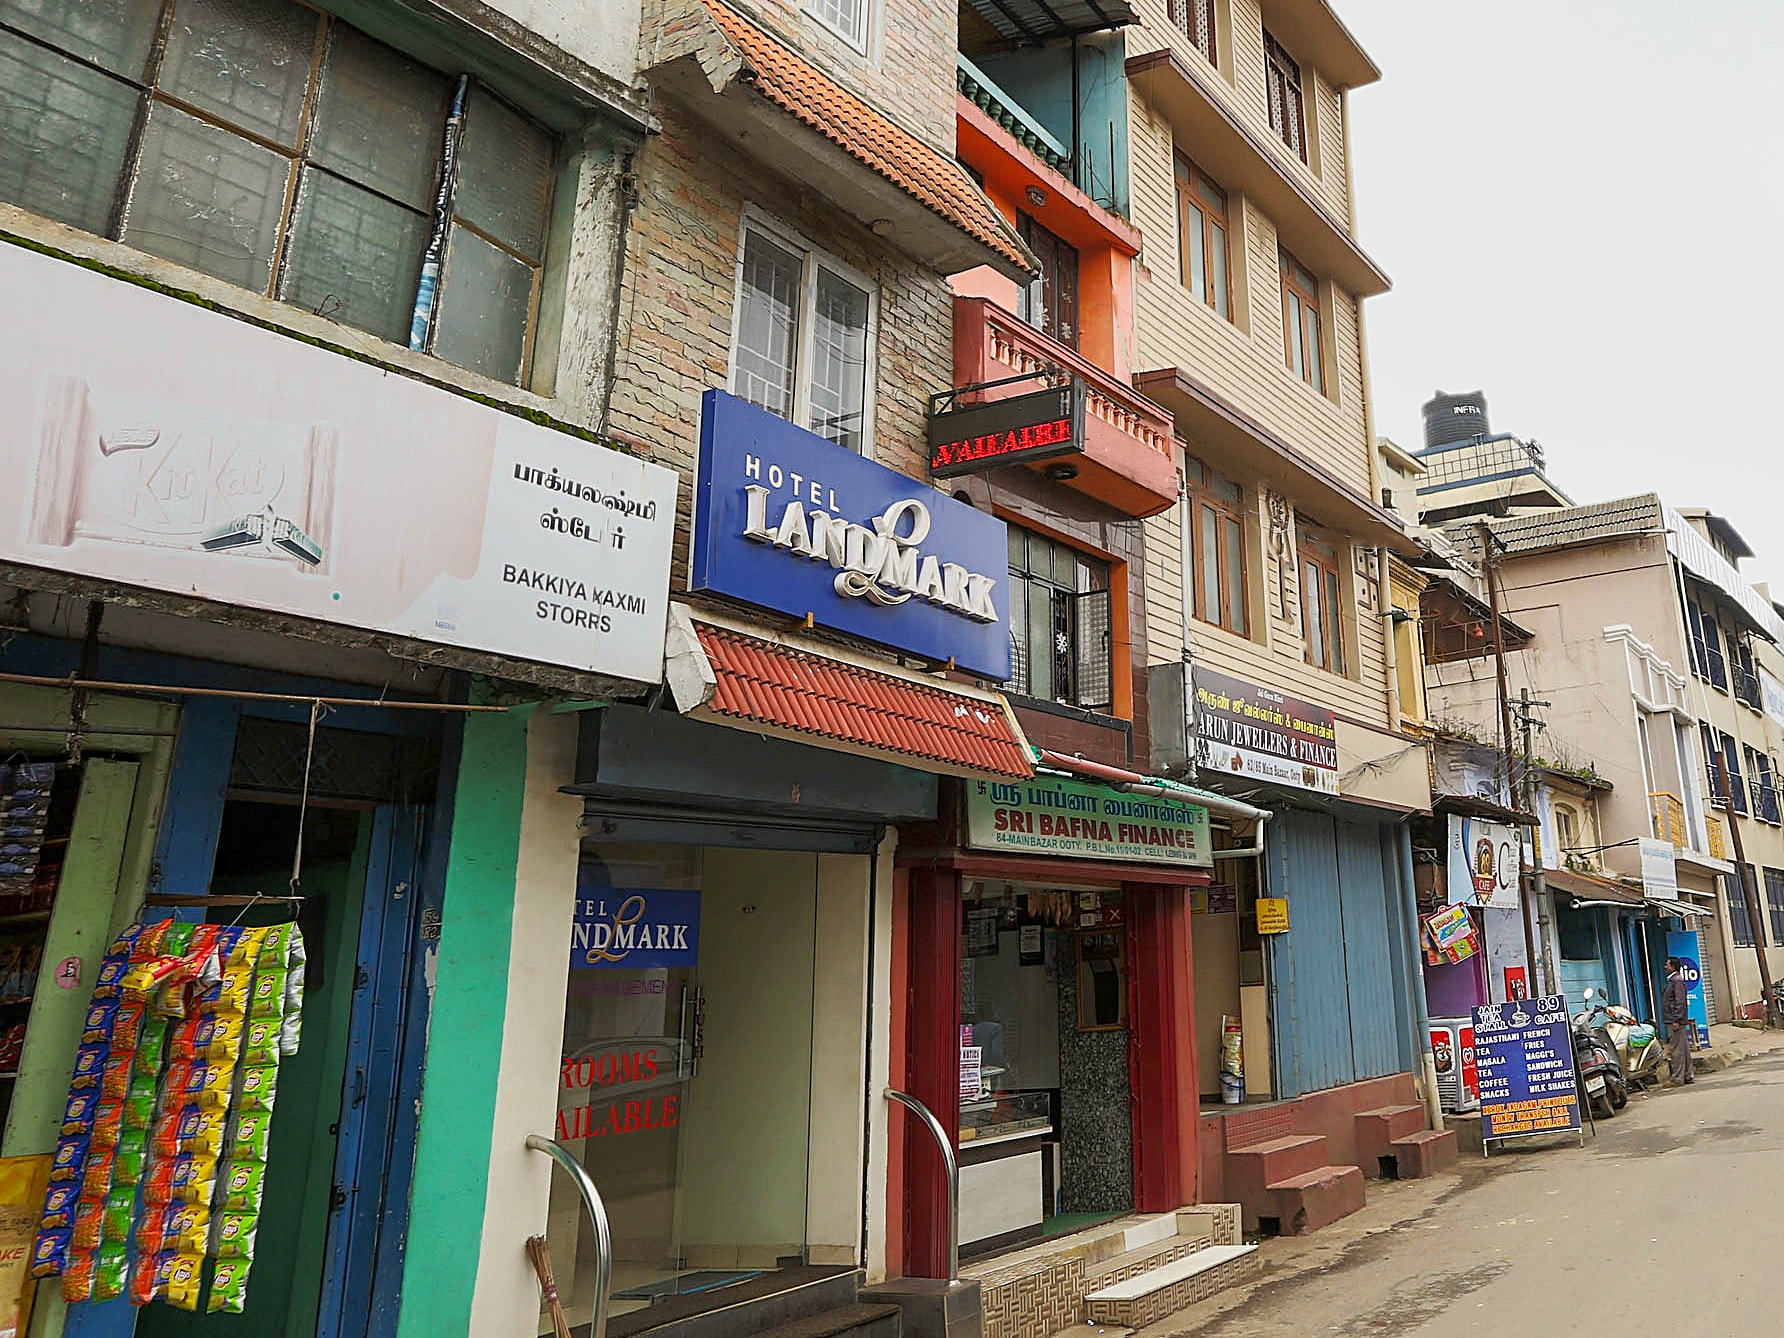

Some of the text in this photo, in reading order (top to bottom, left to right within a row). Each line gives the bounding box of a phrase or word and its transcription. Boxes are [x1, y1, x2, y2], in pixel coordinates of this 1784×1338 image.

[1453, 404, 1481, 415] INFRA
[745, 453, 841, 513] HOTEL
[742, 484, 1000, 625] LANDMARK
[502, 564, 587, 601] BAKKIYA
[1197, 712, 1337, 768] ARUN JEWELLERS & FINANCE
[994, 807, 1195, 849] SRI BAFNA FINANCE
[1477, 1004, 1503, 1016] JAIN
[1536, 996, 1560, 1013] 89
[1480, 1012, 1502, 1024] TEA
[1534, 1011, 1566, 1026] CAFE
[1474, 1032, 1520, 1046] RAJASTHANI
[1523, 1028, 1551, 1040] FRENCH
[1524, 1040, 1545, 1051] FRIES
[1475, 1047, 1491, 1057] TEA
[1525, 1049, 1555, 1061] MAGGI'S
[1476, 1056, 1507, 1067] MASALA
[1526, 1060, 1564, 1072] SANDWICH
[559, 1049, 658, 1089] ROOMS
[1477, 1068, 1493, 1078] TEA
[1527, 1068, 1574, 1083] FRESH JUICE
[1478, 1077, 1509, 1089] COFFEE
[1529, 1083, 1547, 1094] MILK
[1547, 1079, 1576, 1091] SHAKES
[1480, 1088, 1510, 1100] SNACKS
